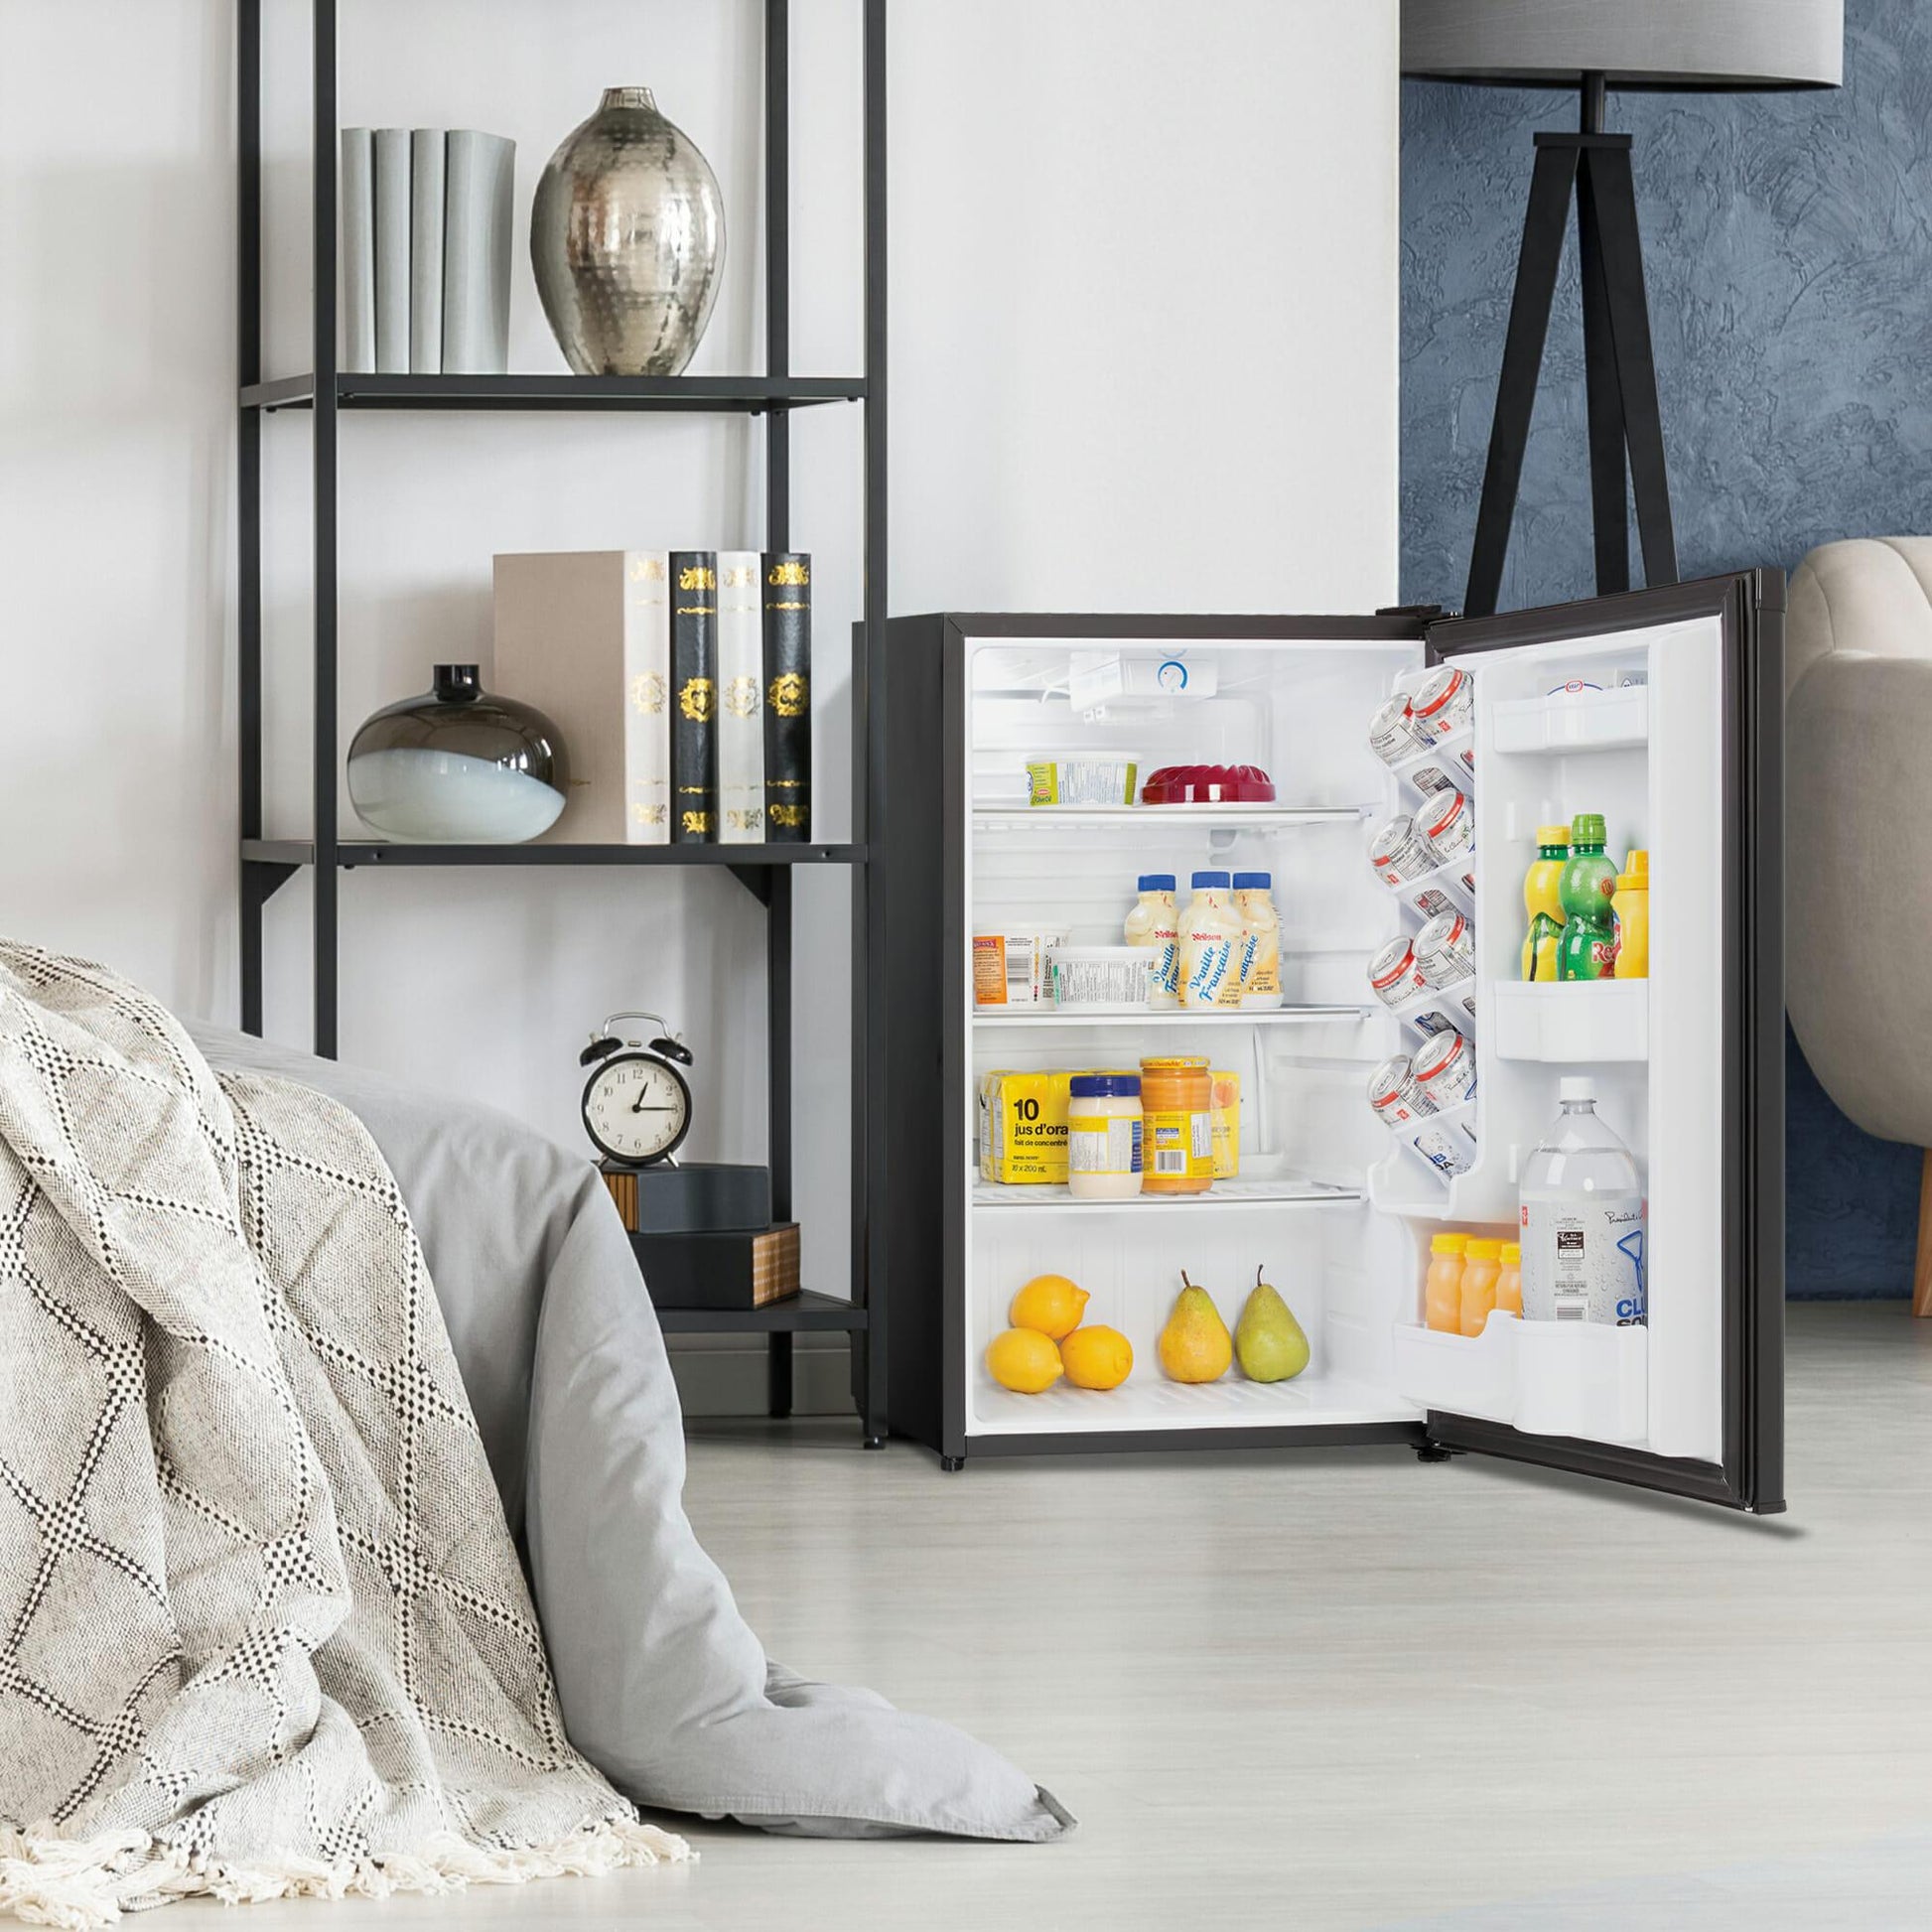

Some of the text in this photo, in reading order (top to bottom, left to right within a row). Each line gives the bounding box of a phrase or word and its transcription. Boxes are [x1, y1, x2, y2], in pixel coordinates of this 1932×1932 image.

[1153, 943, 1175, 983] Vanille
[1188, 946, 1215, 989] Vanille
[1199, 940, 1231, 1001] Française
[618, 1073, 625, 1084] 11
[633, 1069, 643, 1079] 12
[604, 1087, 613, 1097] 10
[665, 1085, 672, 1096] 2
[1014, 1099, 1039, 1121] 10
[603, 1122, 610, 1132] 8
[665, 1122, 671, 1132] 4
[1015, 1123, 1034, 1137] jus
[617, 1134, 623, 1145] 7
[634, 1138, 641, 1149] 6
[655, 1134, 662, 1145] 5
